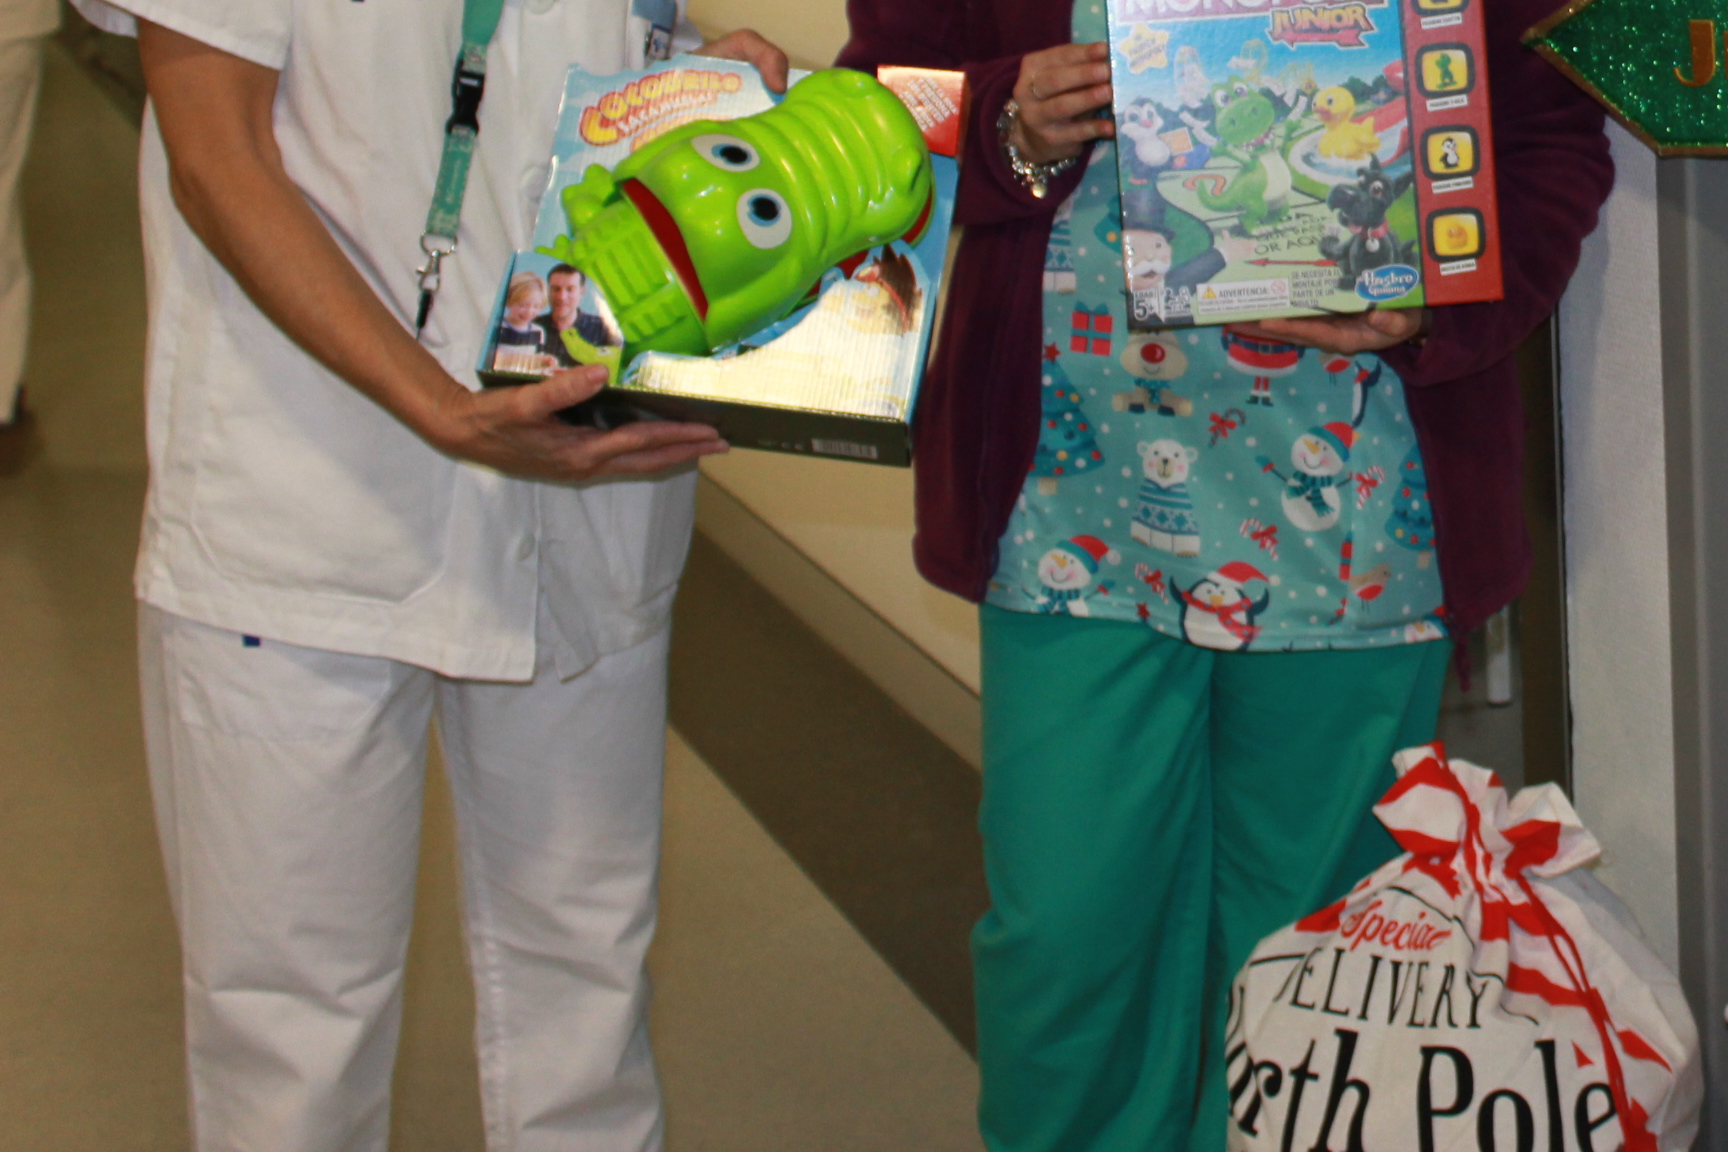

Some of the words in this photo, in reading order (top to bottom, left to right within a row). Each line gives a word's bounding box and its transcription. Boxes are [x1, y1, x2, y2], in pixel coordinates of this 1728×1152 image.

[1271, 4, 1371, 33] JUNIOR
[1361, 270, 1414, 287] Hasbro
[1416, 1039, 1620, 1152] Pole
